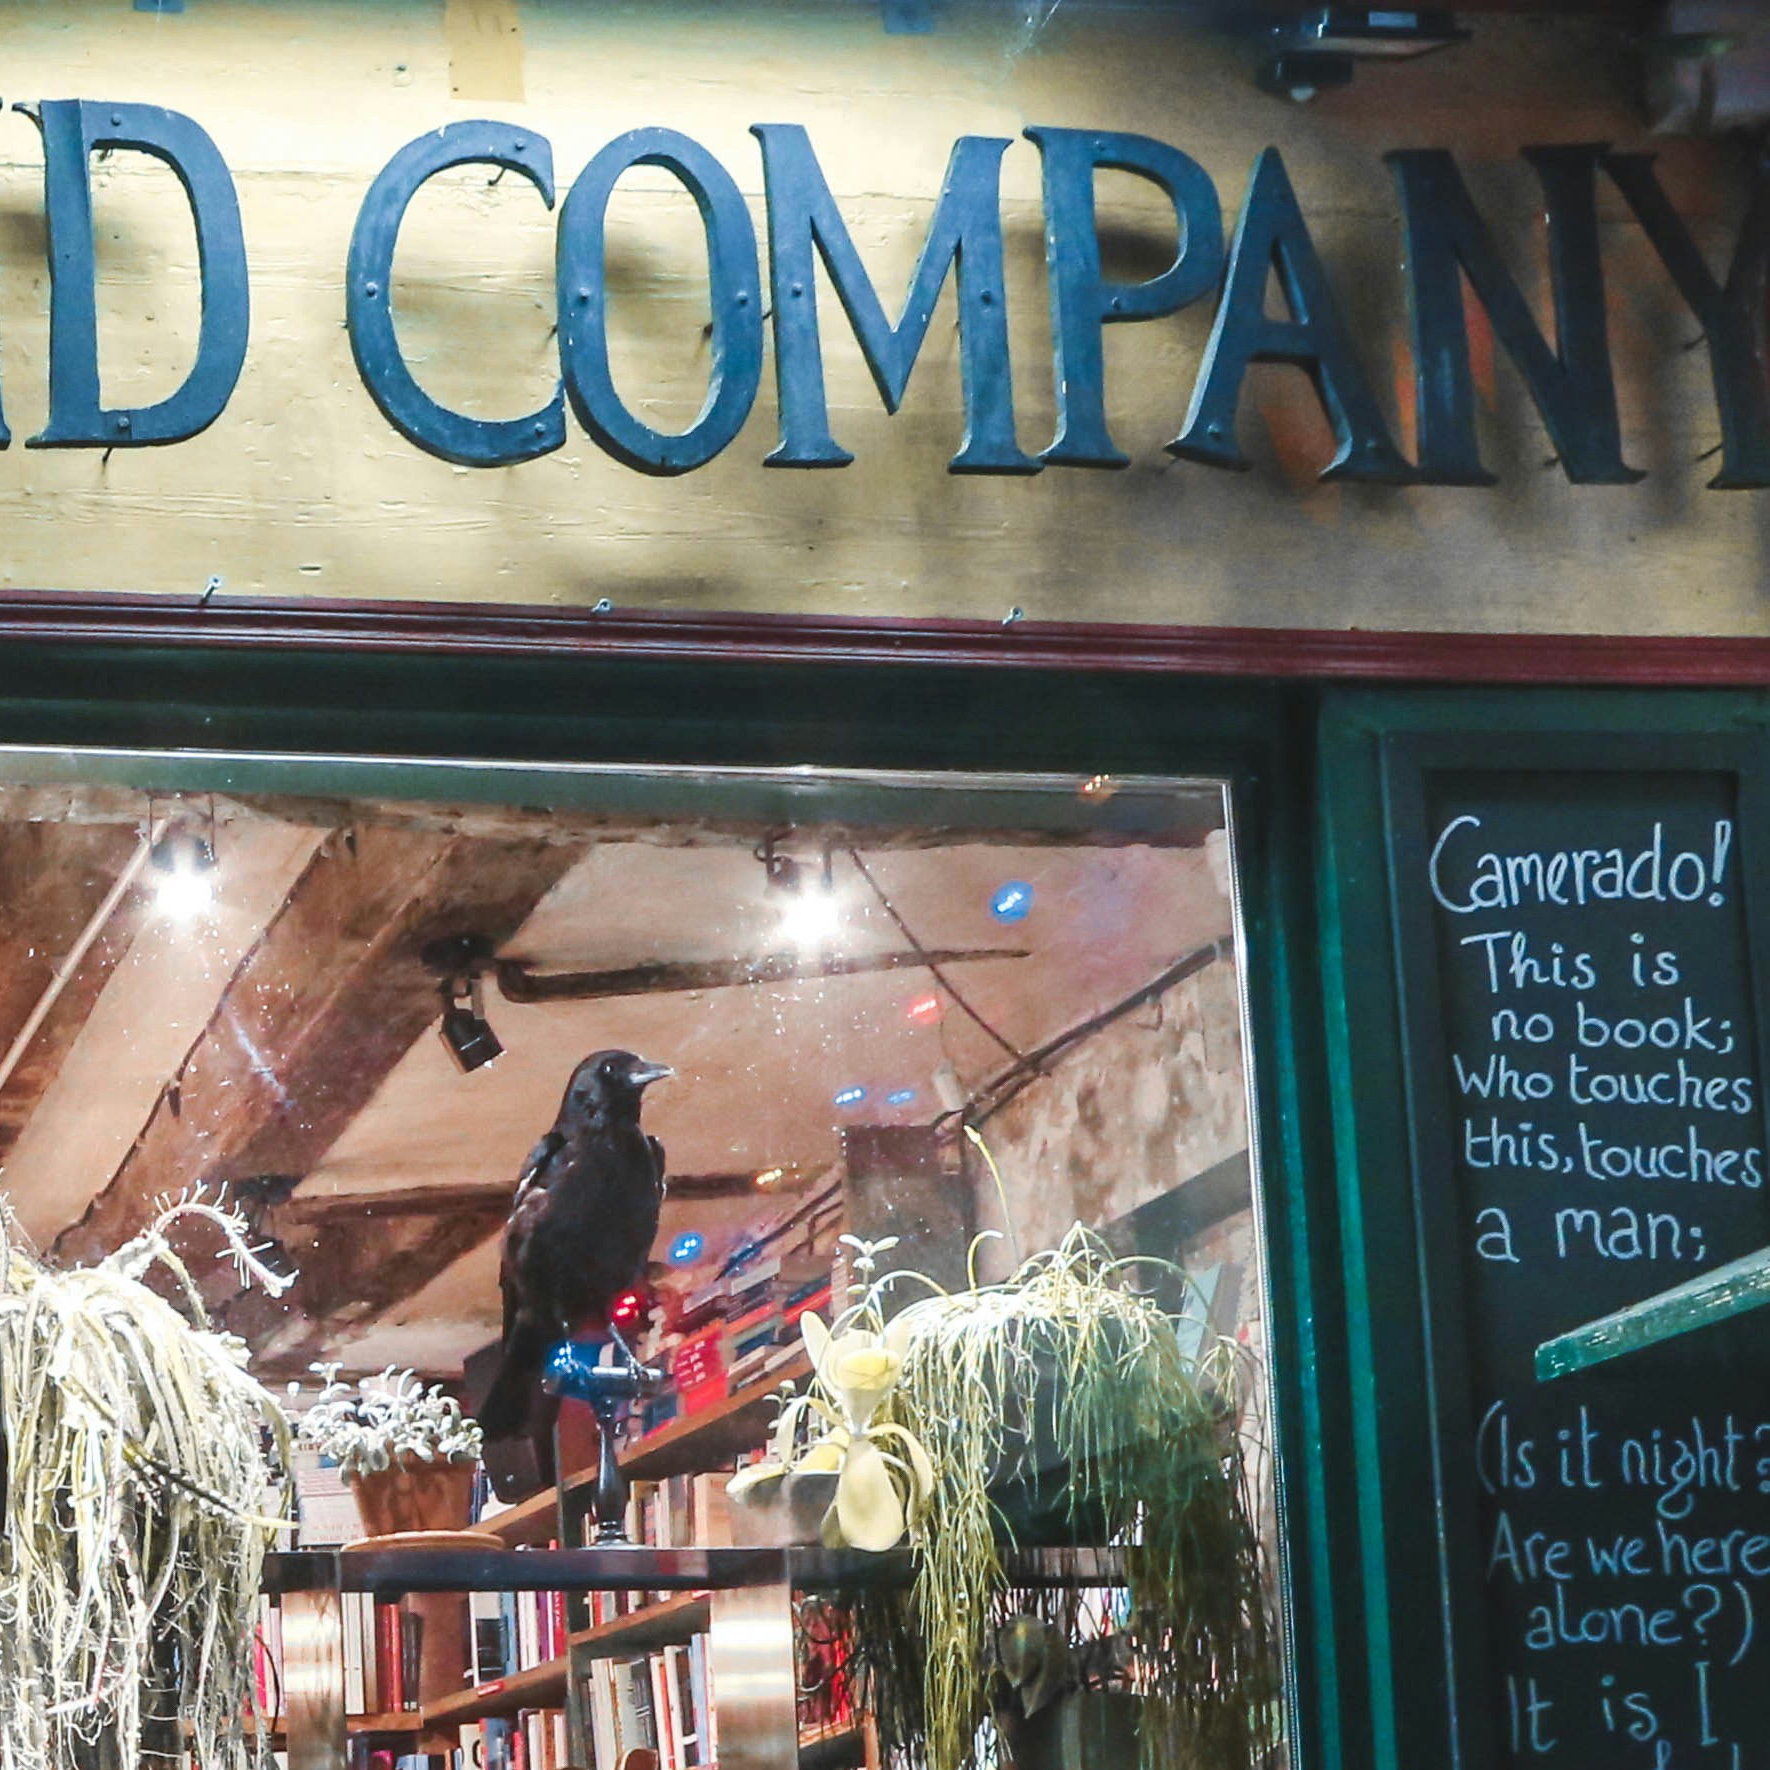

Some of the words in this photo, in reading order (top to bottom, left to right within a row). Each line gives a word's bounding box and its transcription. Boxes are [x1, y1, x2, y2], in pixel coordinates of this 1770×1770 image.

[345, 118, 1770, 488] COMPANY
[1429, 815, 1732, 913] Camerado!
[1460, 931, 1596, 993] This
[1631, 933, 1680, 987] is
[1492, 1008, 1554, 1046] no
[1576, 997, 1734, 1054] book;
[1569, 1054, 1753, 1114] touches
[1464, 1117, 1574, 1174] this,
[1579, 1123, 1762, 1188] touches
[1476, 1207, 1520, 1262] a
[1555, 1207, 1707, 1262] man;
[1559, 1405, 1602, 1488] it
[1487, 1510, 1572, 1584] Are
[1587, 1536, 1651, 1576] we
[1525, 1581, 1753, 1666] alone?)
[1507, 1675, 1556, 1755] It
[1601, 1675, 1658, 1742] is
